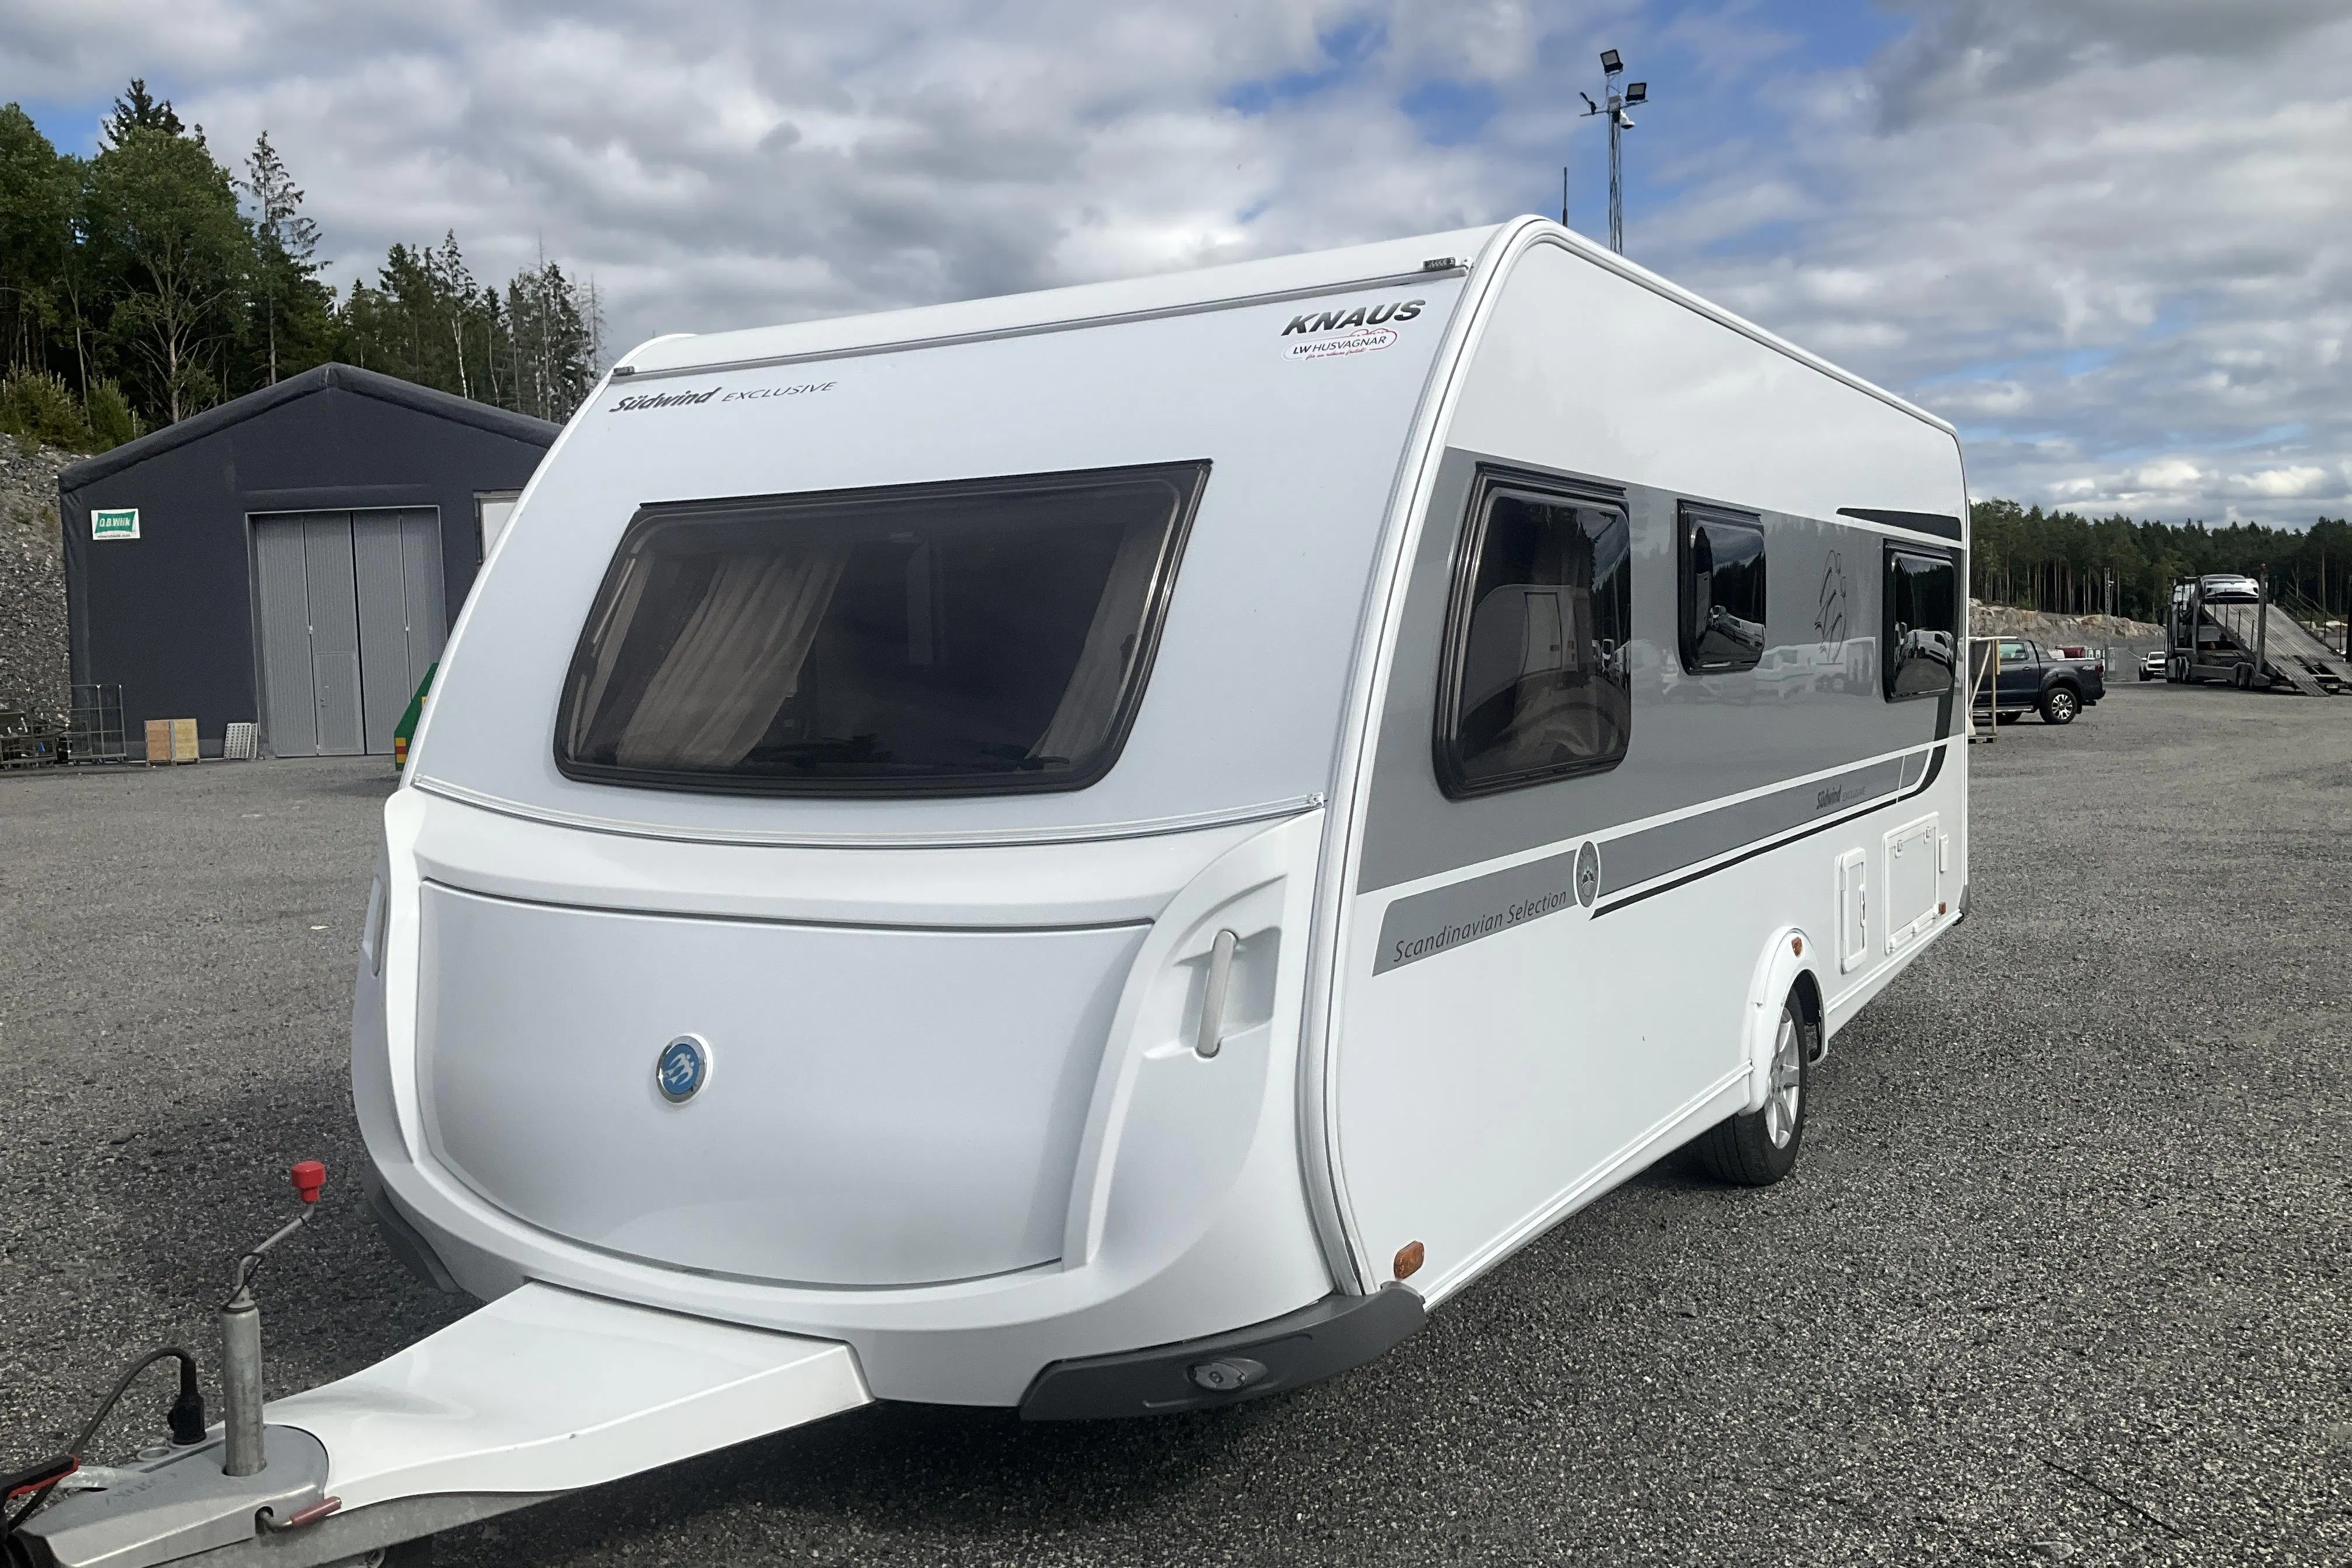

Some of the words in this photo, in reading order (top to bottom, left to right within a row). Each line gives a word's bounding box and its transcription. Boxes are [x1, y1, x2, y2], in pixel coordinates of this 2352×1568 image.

[1281, 300, 1426, 336] KNAUS
[1293, 344, 1312, 355] LW
[1313, 336, 1387, 352] HUSVAGNAR
[609, 387, 722, 412] Südwind
[722, 382, 836, 402] EXCLUSIVE
[1394, 914, 1503, 963] Scandinavian
[1507, 891, 1566, 924] Selection
